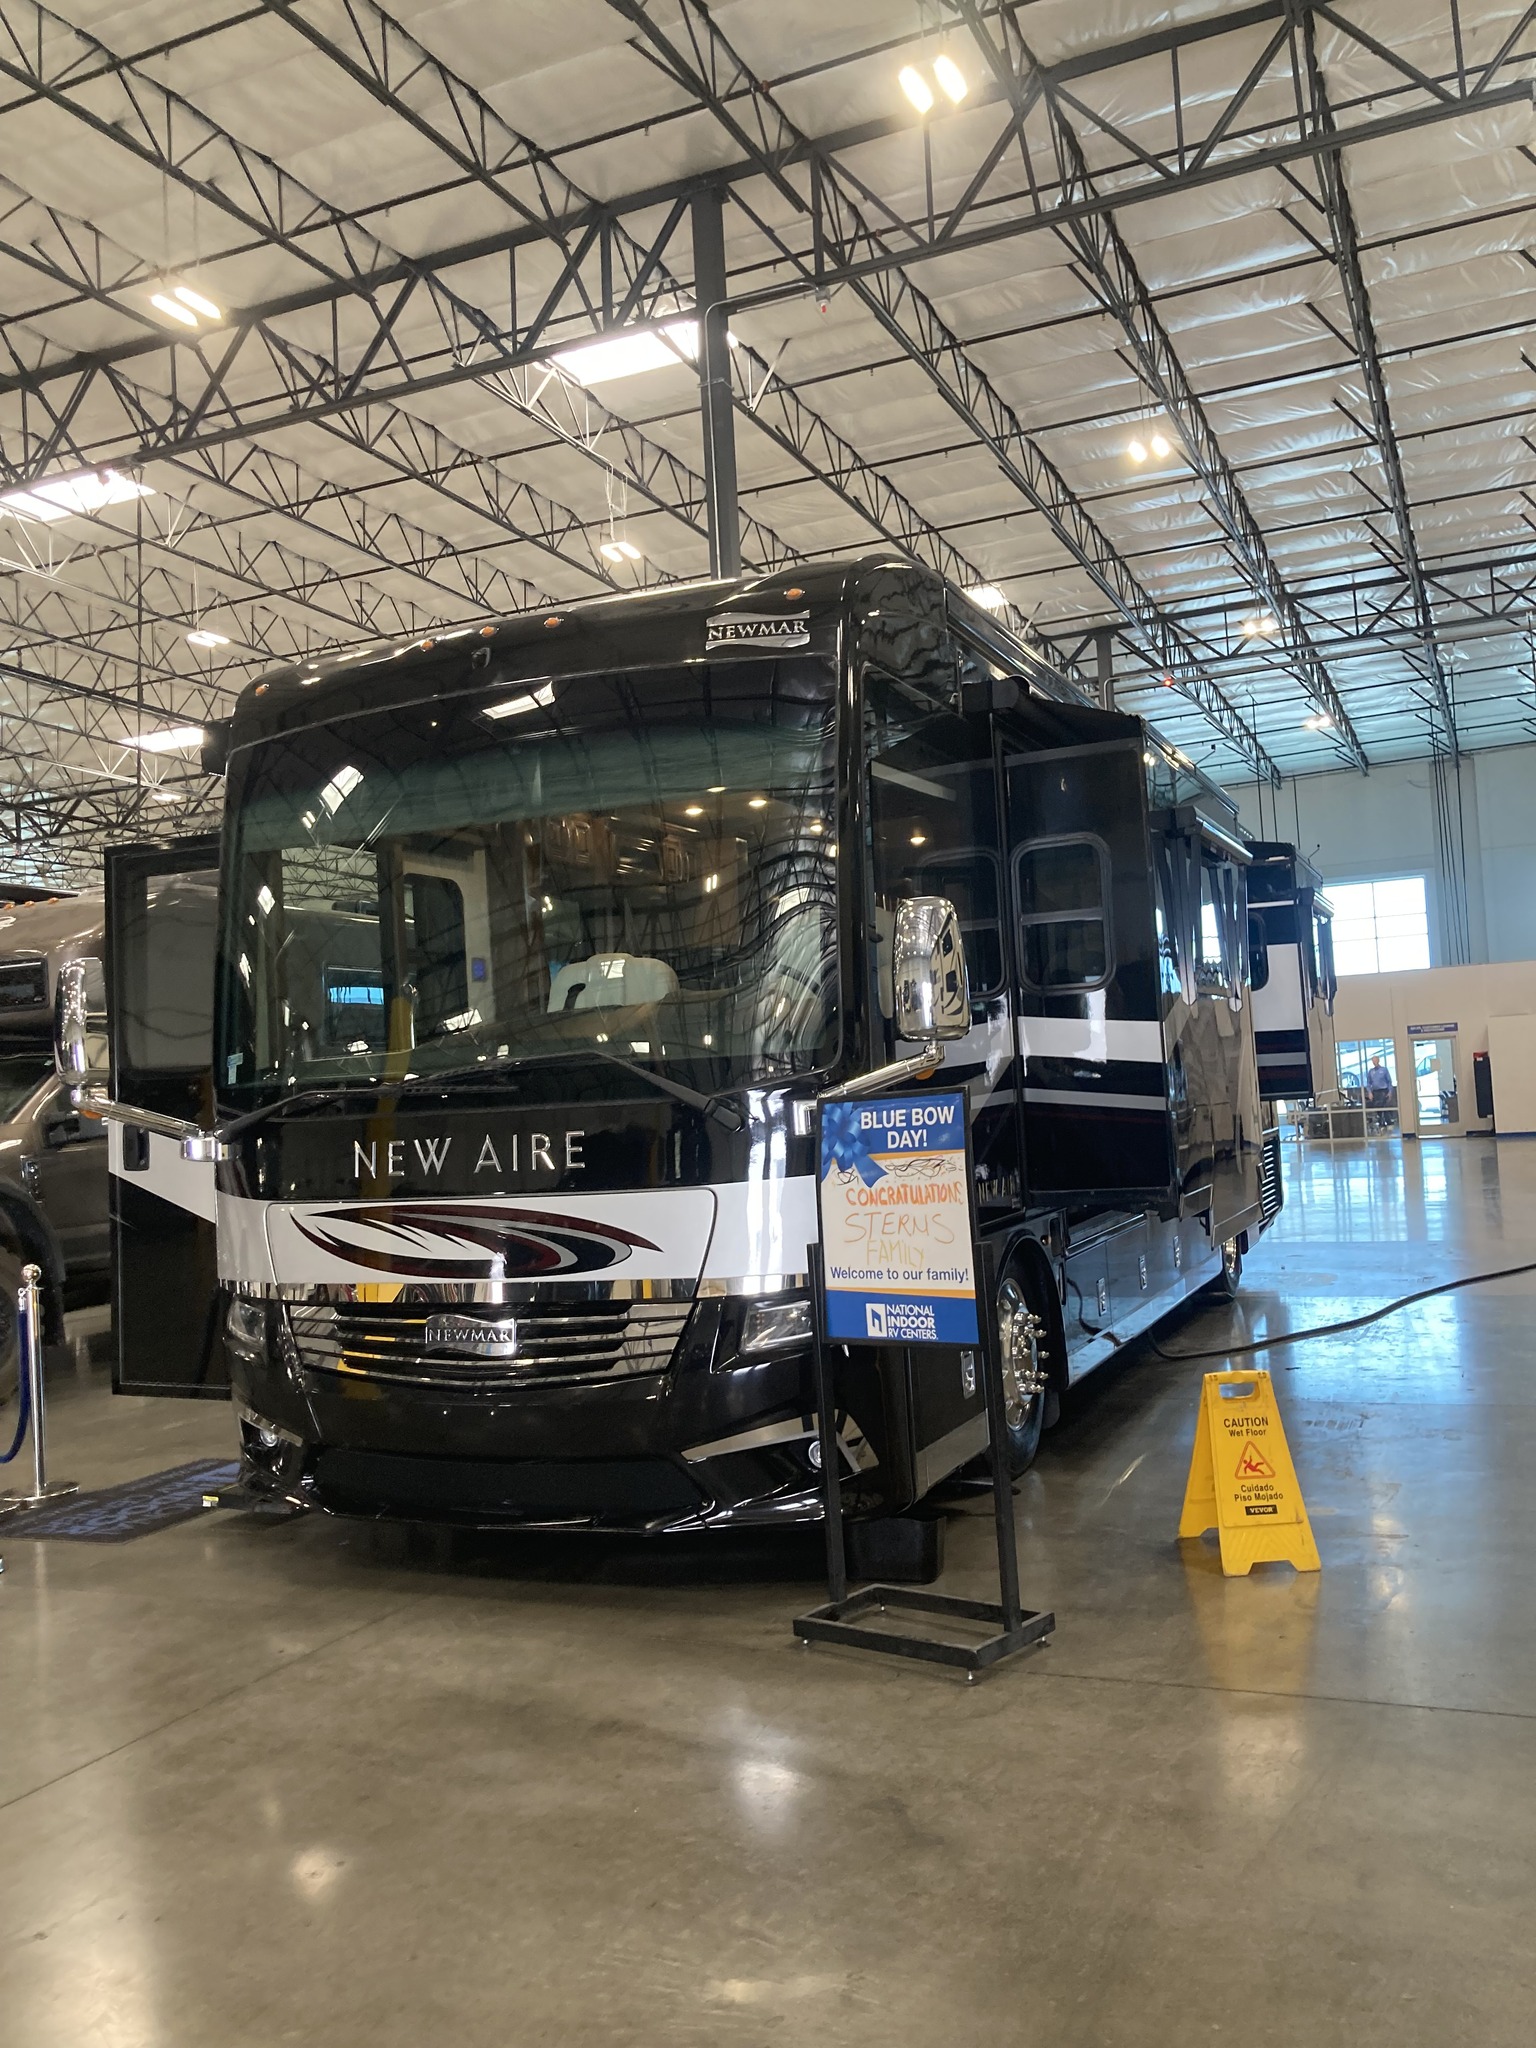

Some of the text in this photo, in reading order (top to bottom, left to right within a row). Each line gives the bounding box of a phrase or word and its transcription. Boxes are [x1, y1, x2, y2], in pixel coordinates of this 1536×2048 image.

[707, 620, 809, 641] NEWMAR
[861, 1105, 955, 1130] BLUE BOW
[887, 1129, 928, 1149] DAY!
[354, 1130, 586, 1179] NEW AIRE
[845, 1181, 964, 1206] CONGRATULATIONS
[866, 1239, 925, 1268] FAMILY
[830, 1266, 969, 1284] Welcome to our family!
[886, 1303, 936, 1317] NATIONAL
[887, 1316, 936, 1330] INDOOR
[428, 1328, 512, 1342] NEWMAR
[888, 1328, 900, 1339] RV
[1223, 1416, 1269, 1428] CAUTION
[1229, 1428, 1267, 1438] Wet Floor
[1240, 1484, 1275, 1493] Cuidado
[1234, 1491, 1284, 1503] Piso Mojado
[1249, 1506, 1274, 1514] VEVOR
